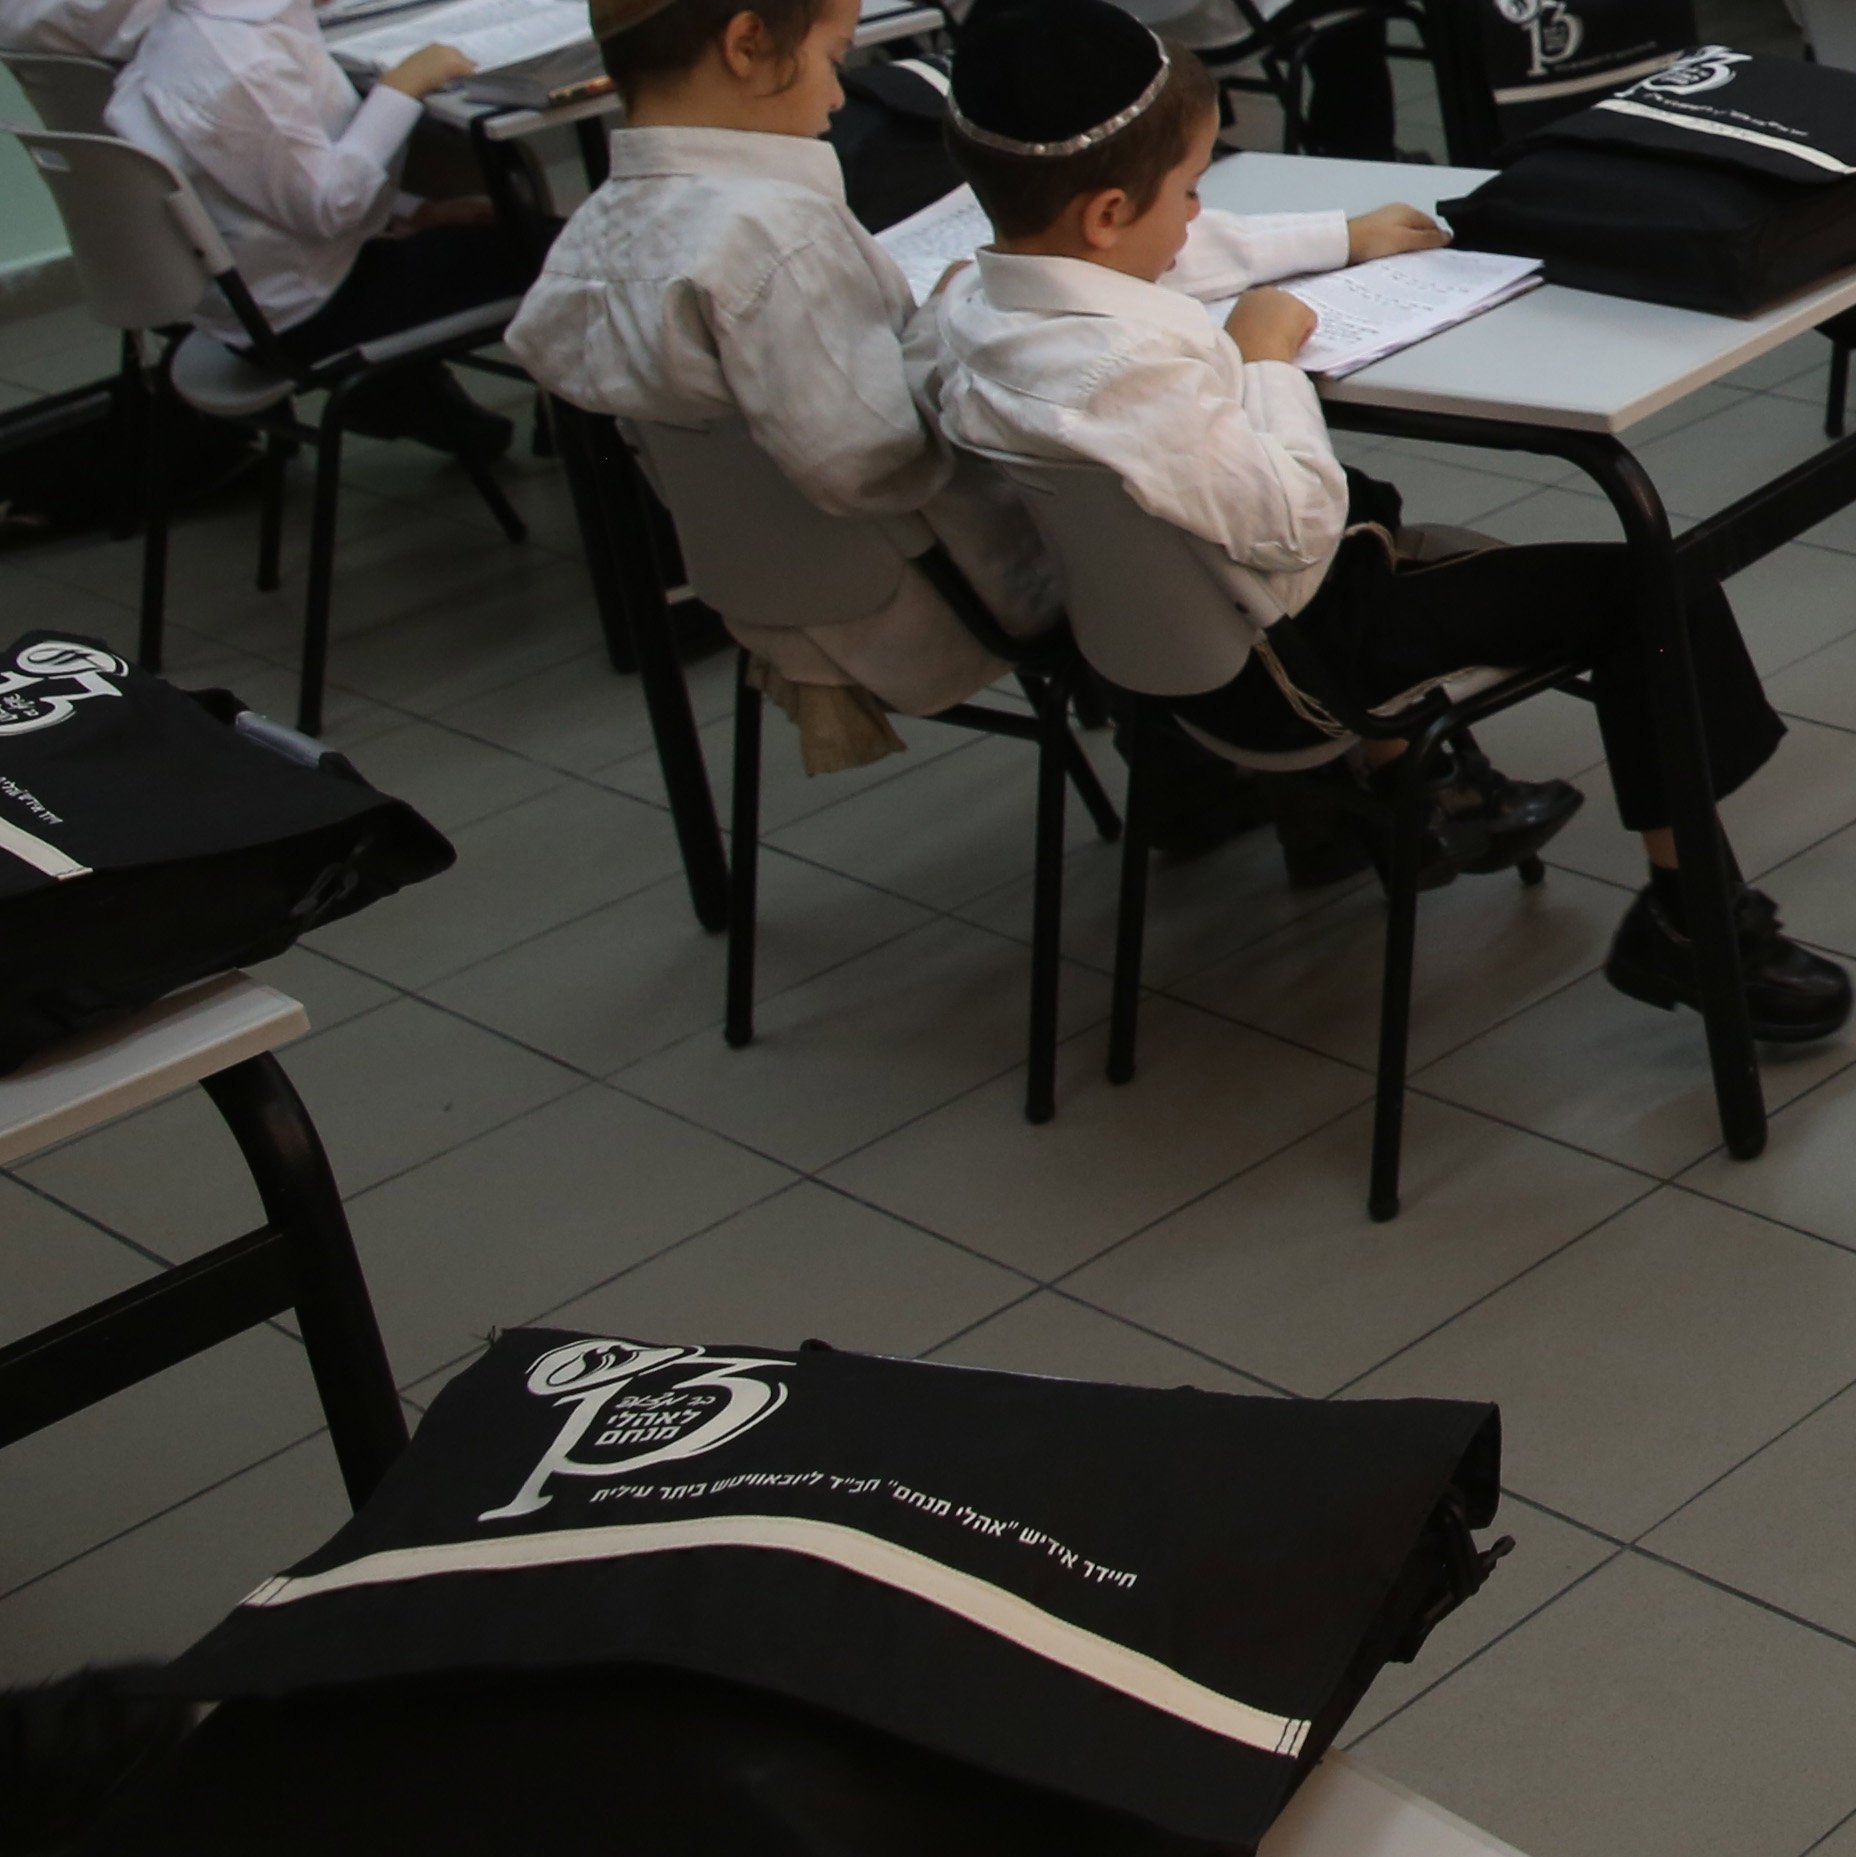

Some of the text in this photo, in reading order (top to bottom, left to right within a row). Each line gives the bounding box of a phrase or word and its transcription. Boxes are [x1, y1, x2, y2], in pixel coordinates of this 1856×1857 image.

[606, 1408, 703, 1428] לאהלי
[594, 1425, 682, 1446] מנחם
[589, 1484, 654, 1504] עילית
[658, 1482, 708, 1501] ביתר
[1018, 1525, 1080, 1569] אידיש
[1083, 1558, 1138, 1589] חיידר
